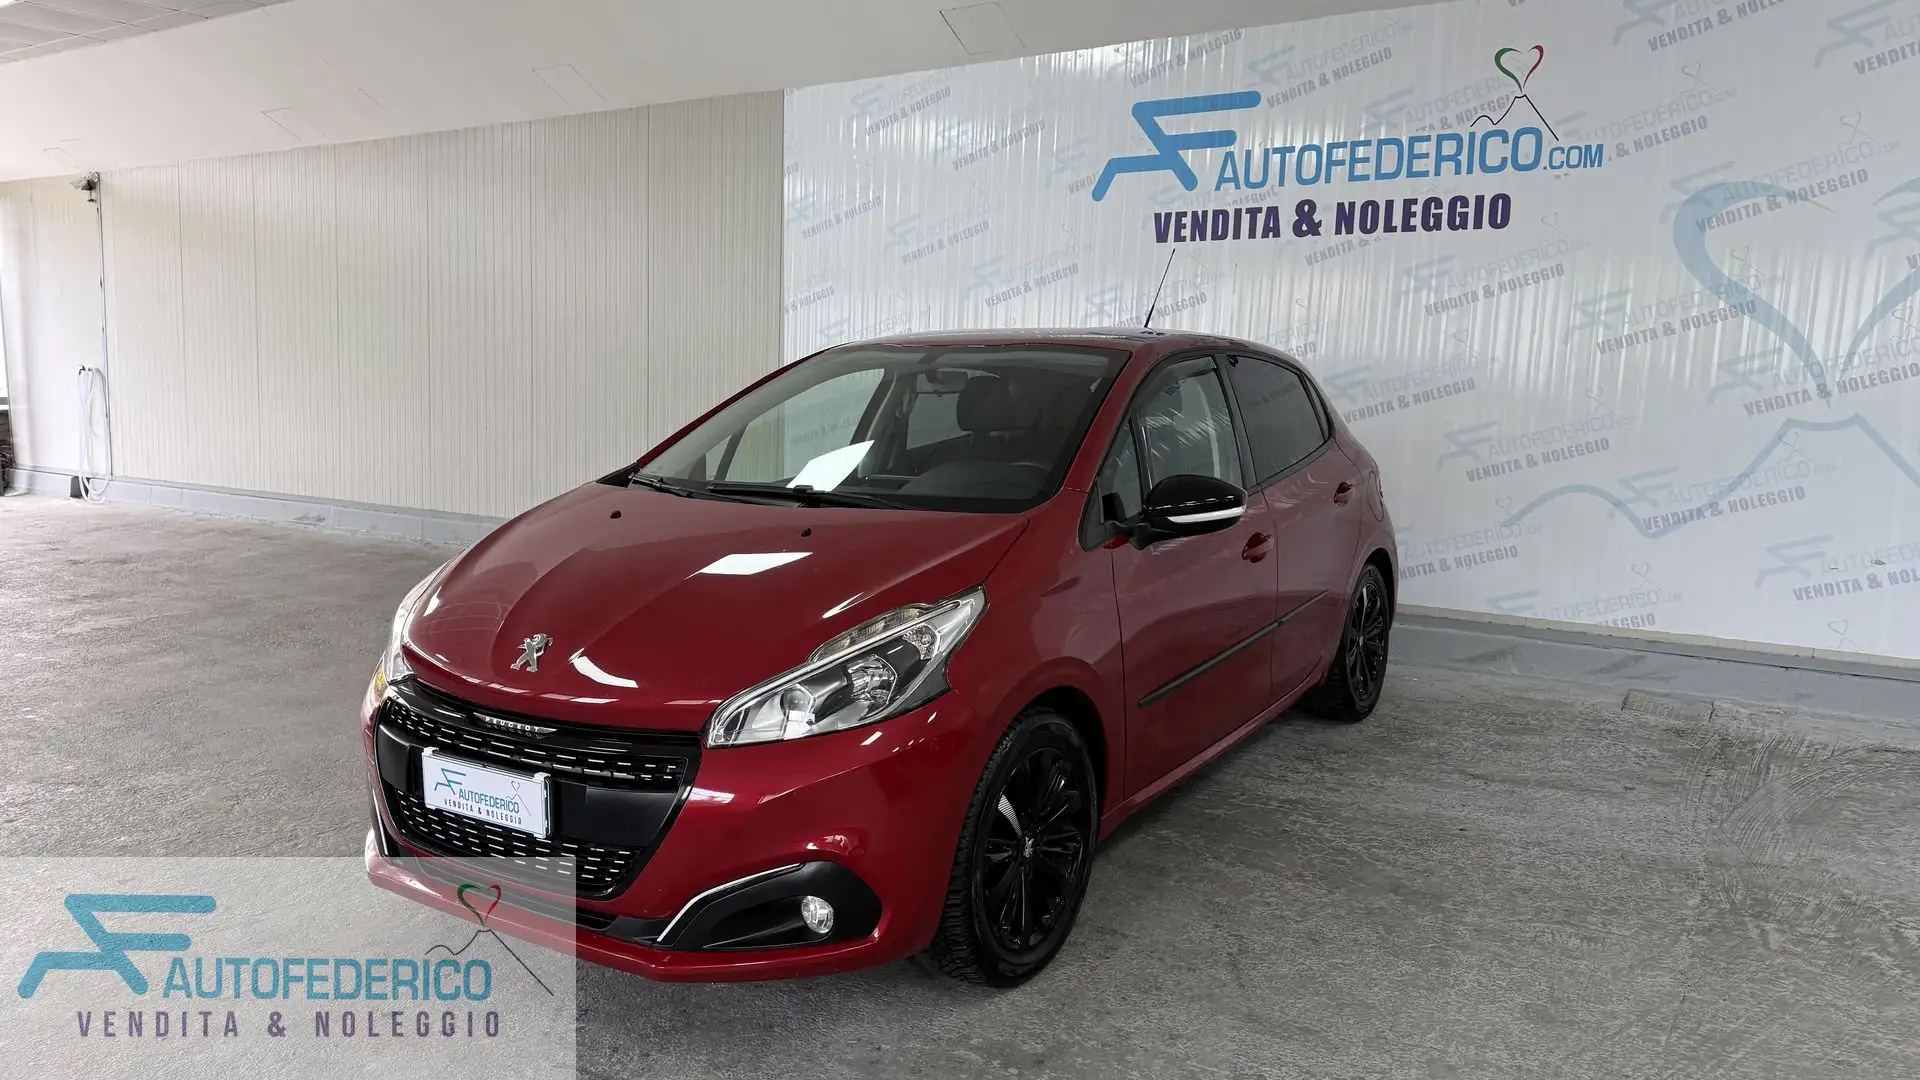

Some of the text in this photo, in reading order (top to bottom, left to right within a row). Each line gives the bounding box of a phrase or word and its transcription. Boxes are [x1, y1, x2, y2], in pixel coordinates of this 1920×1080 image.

[1647, 16, 1714, 51] VENDITA
[1716, 9, 1732, 25] &
[1266, 46, 1392, 108] VENDITA & NOLEGGIO
[1853, 38, 1920, 75] VENDIT
[1615, 115, 1708, 158] & NOLEGGIO
[1154, 193, 1512, 244] VENDITA & NOLEGGIO
[1696, 168, 1868, 233] VENDITA & NOLEGGIO
[1424, 263, 1565, 316] VENDITA & NOLEGGIO
[1597, 300, 1757, 354] VENDITA & NOLEGGIO
[1343, 377, 1476, 424] VENDITA & NOLEGGIO
[1743, 362, 1920, 418] VENDITA & NOLEGGIO
[1465, 437, 1610, 482] VENDITA & NOLEGGIO
[1643, 485, 1807, 533] VENDITA & NOLEGGIO
[1399, 544, 1519, 580] NDITA & NOLEGGIO
[1792, 578, 1863, 601] VENDITA
[1866, 572, 1884, 589] &
[485, 715, 541, 733] PEUGEOT
[444, 798, 522, 826] VENDITA & NOLEGGIO
[458, 788, 520, 814] AUTOFEDERICO
